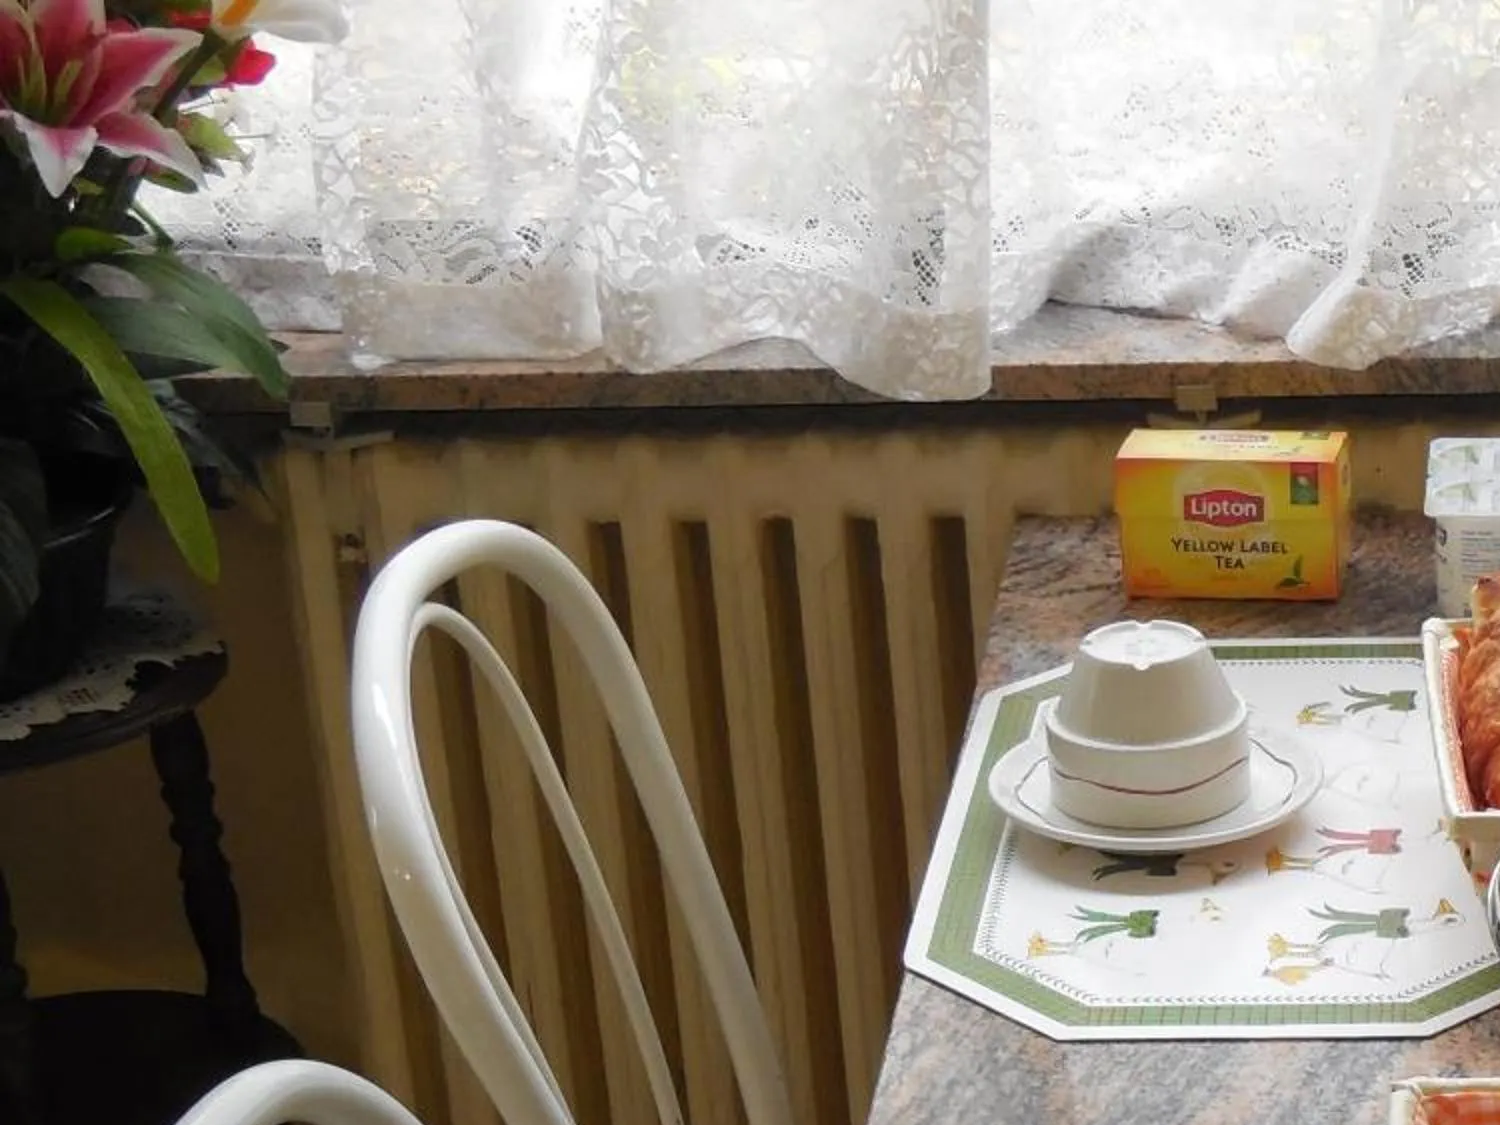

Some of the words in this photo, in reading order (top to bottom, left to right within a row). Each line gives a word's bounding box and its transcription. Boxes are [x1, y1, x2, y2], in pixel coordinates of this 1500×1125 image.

[1191, 498, 1257, 519] Lipton
[1171, 538, 1235, 553] YELLOW
[1240, 540, 1288, 555] LABEL
[1216, 556, 1245, 570] TEA
